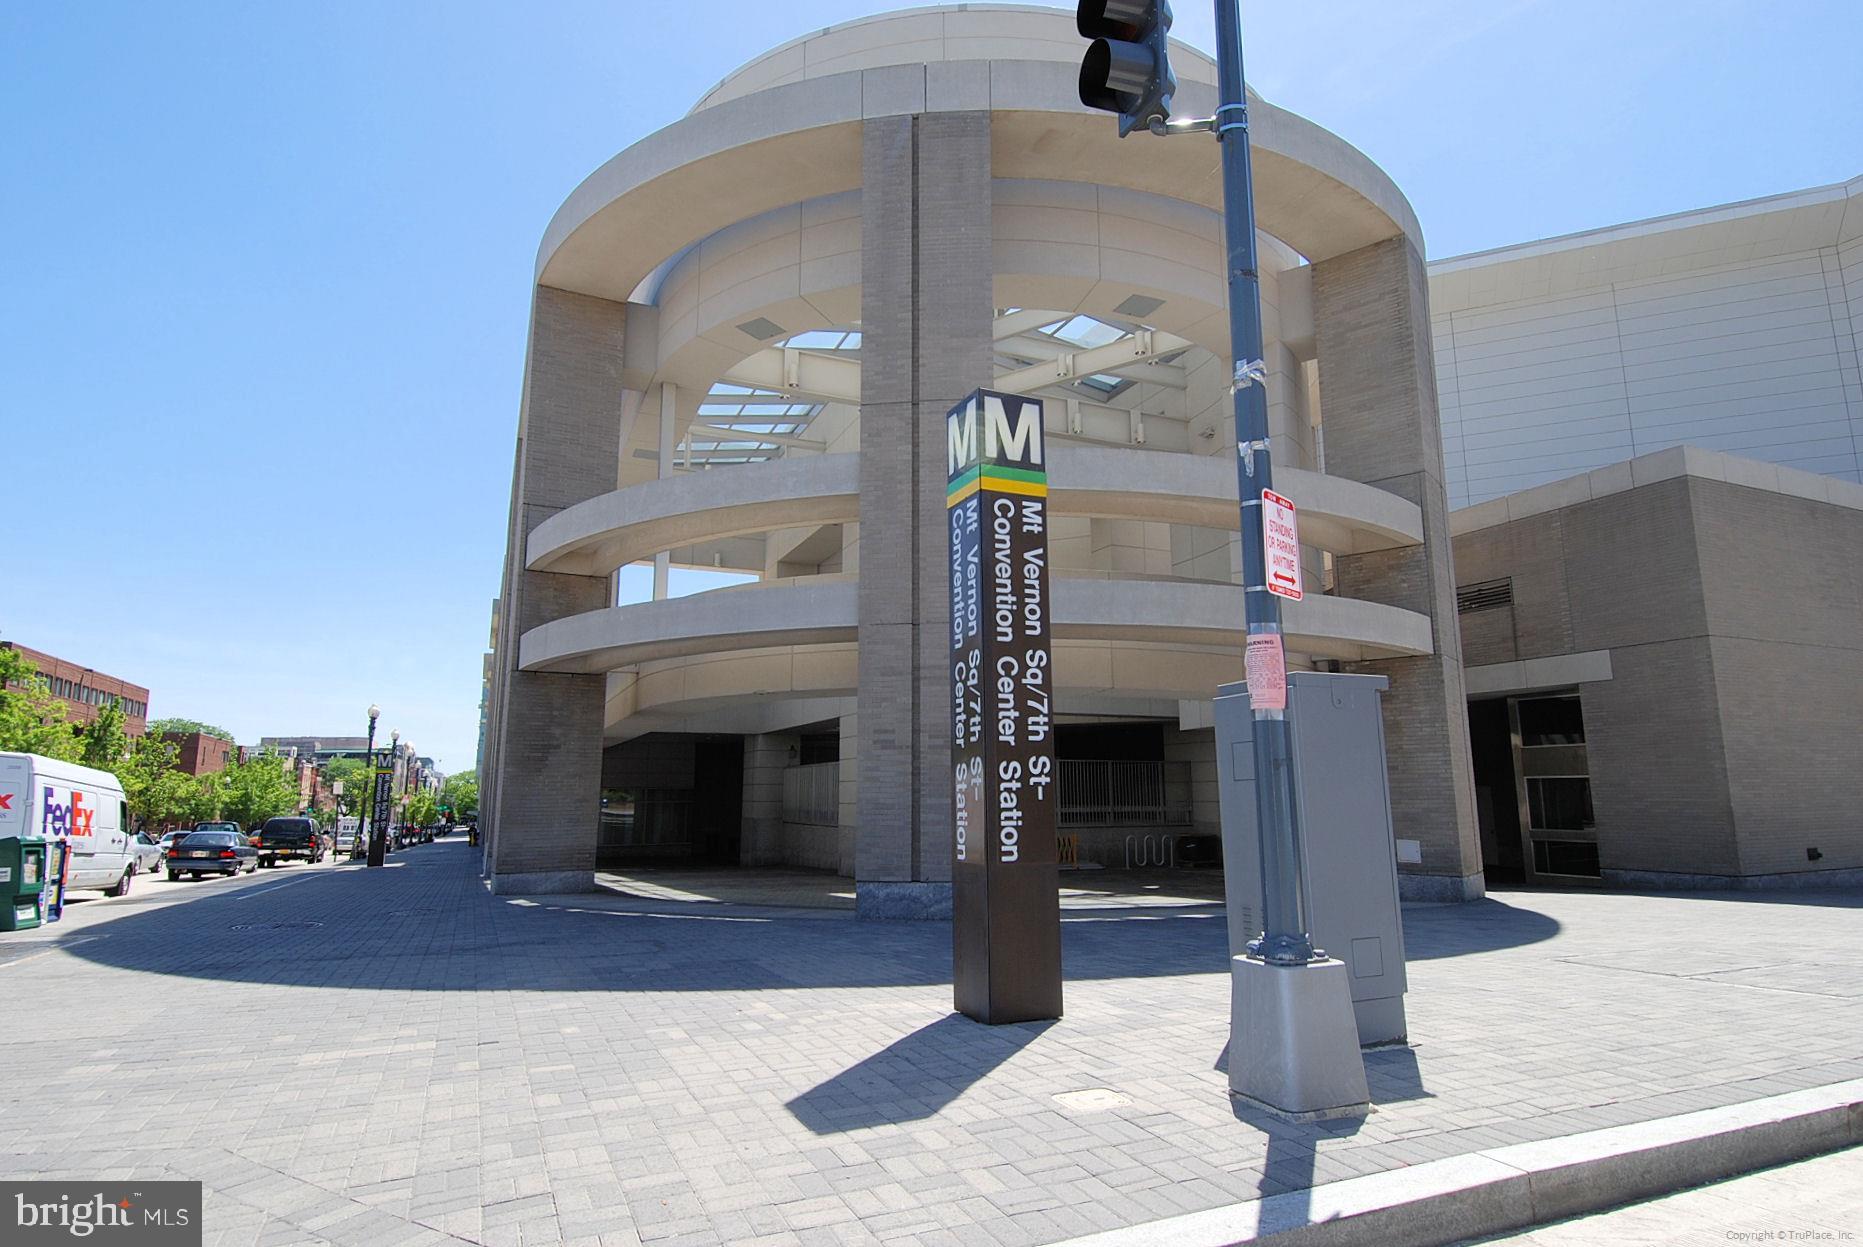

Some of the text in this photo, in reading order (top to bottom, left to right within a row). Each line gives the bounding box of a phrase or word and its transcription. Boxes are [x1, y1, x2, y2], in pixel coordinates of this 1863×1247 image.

[947, 397, 977, 477] M
[984, 395, 1042, 465] M
[1269, 519, 1294, 540] STANDING
[1276, 507, 1285, 520] NO
[1267, 535, 1297, 557] OR PARKING
[1272, 553, 1296, 572] ANYTIME
[966, 498, 982, 802] Mt Vernon Sq/7th St-
[1021, 500, 1051, 801] Mt Vernon Sq/7th St-
[951, 508, 968, 861] Convention Center Station
[993, 498, 1023, 863] Convention Center Station
[377, 754, 392, 768] M
[42, 786, 95, 837] FedEx
[376, 774, 384, 802] Convention
